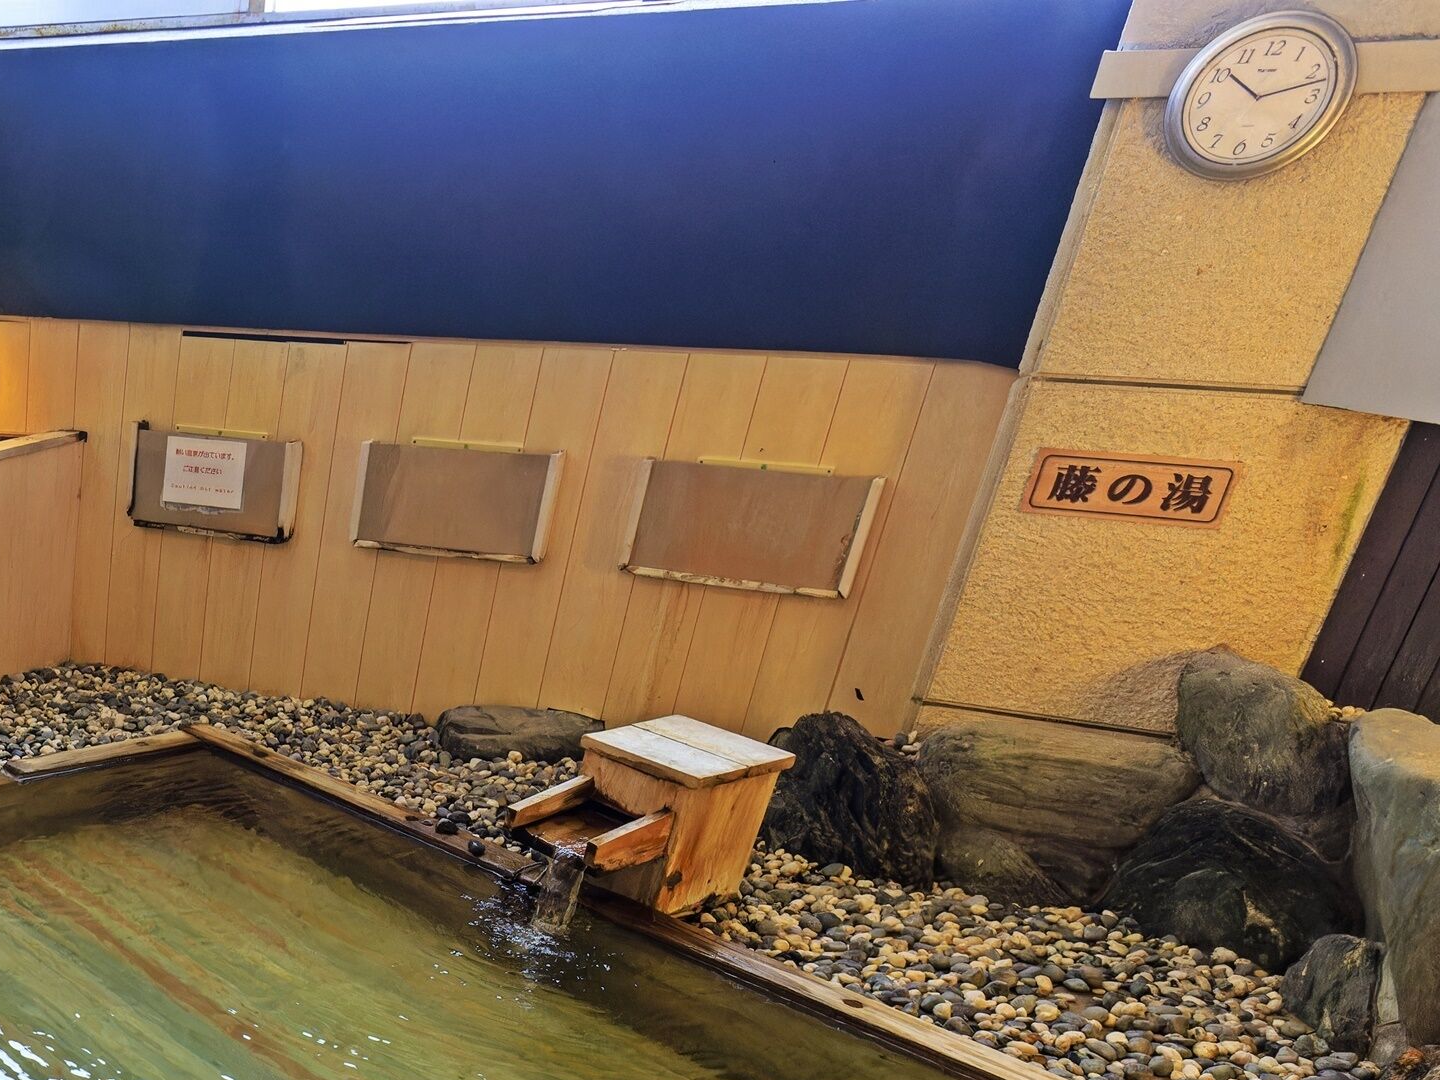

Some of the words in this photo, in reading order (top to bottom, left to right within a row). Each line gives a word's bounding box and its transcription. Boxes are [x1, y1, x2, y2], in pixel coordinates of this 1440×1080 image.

[1236, 48, 1256, 65] 11
[1263, 40, 1287, 56] 12
[1293, 46, 1306, 62] 1
[1209, 67, 1232, 84] 10
[1305, 63, 1321, 80] 2
[1196, 91, 1212, 109] 9
[1304, 88, 1320, 105] 3
[1196, 116, 1211, 132] 8
[1288, 113, 1303, 130] 4
[1208, 133, 1223, 149] 7
[1232, 138, 1247, 156] 6
[1260, 133, 1276, 148] 5
[1046, 464, 1214, 514] 藤の湯
